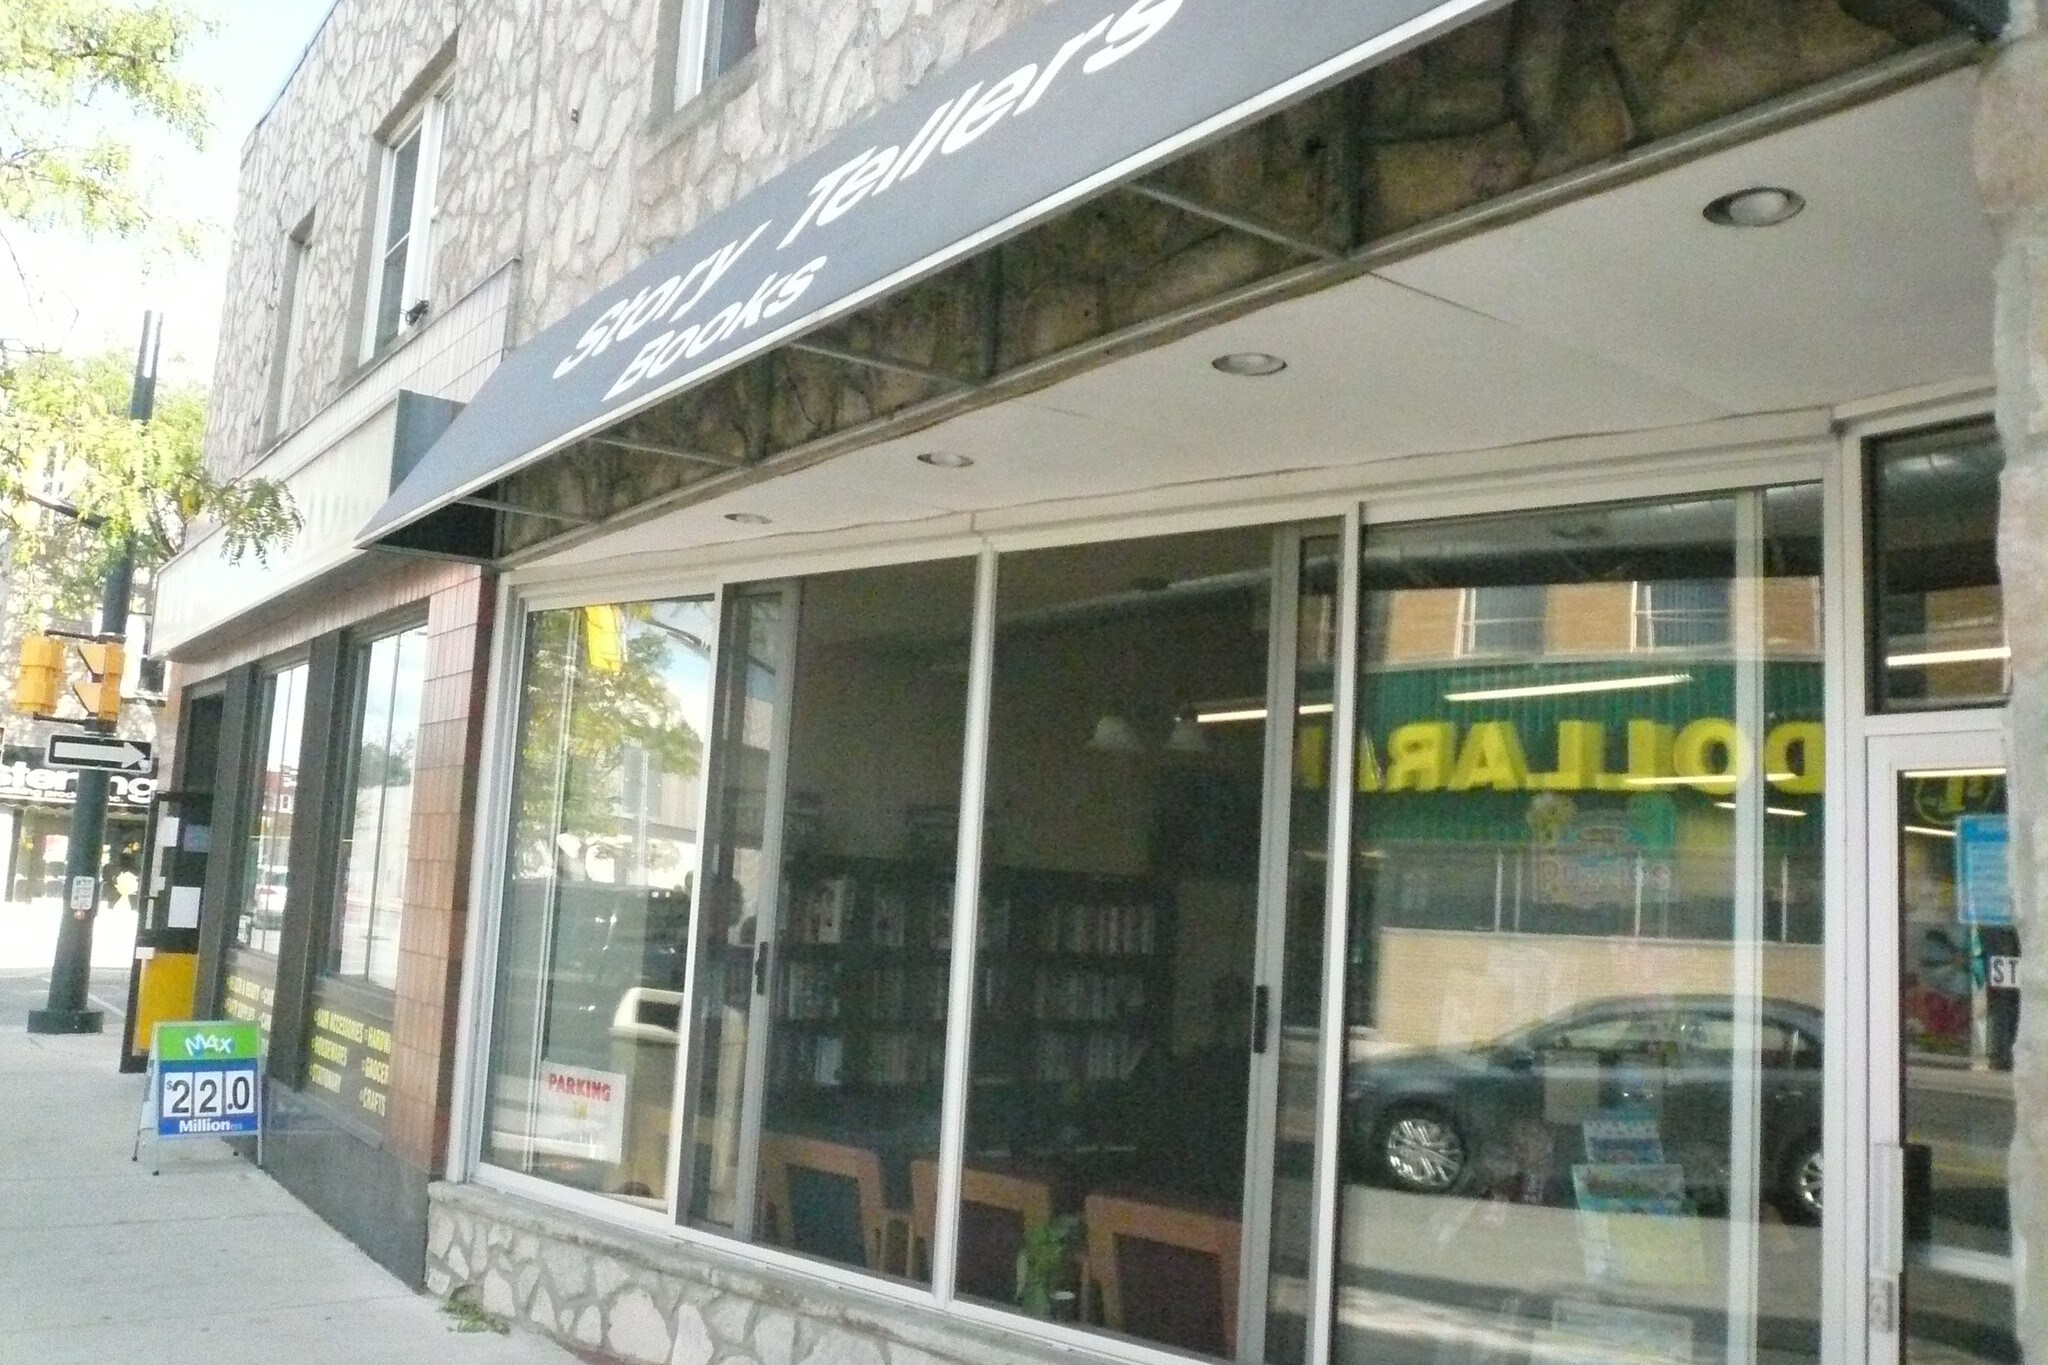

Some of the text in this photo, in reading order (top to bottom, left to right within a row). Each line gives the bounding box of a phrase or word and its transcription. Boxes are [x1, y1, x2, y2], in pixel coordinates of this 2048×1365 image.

[553, 0, 1184, 380] Story Tellers
[602, 256, 828, 401] Books
[0, 760, 158, 804] sterng
[184, 1033, 232, 1057] MAX
[548, 1072, 612, 1102] PARKING
[179, 1118, 231, 1134] Million
